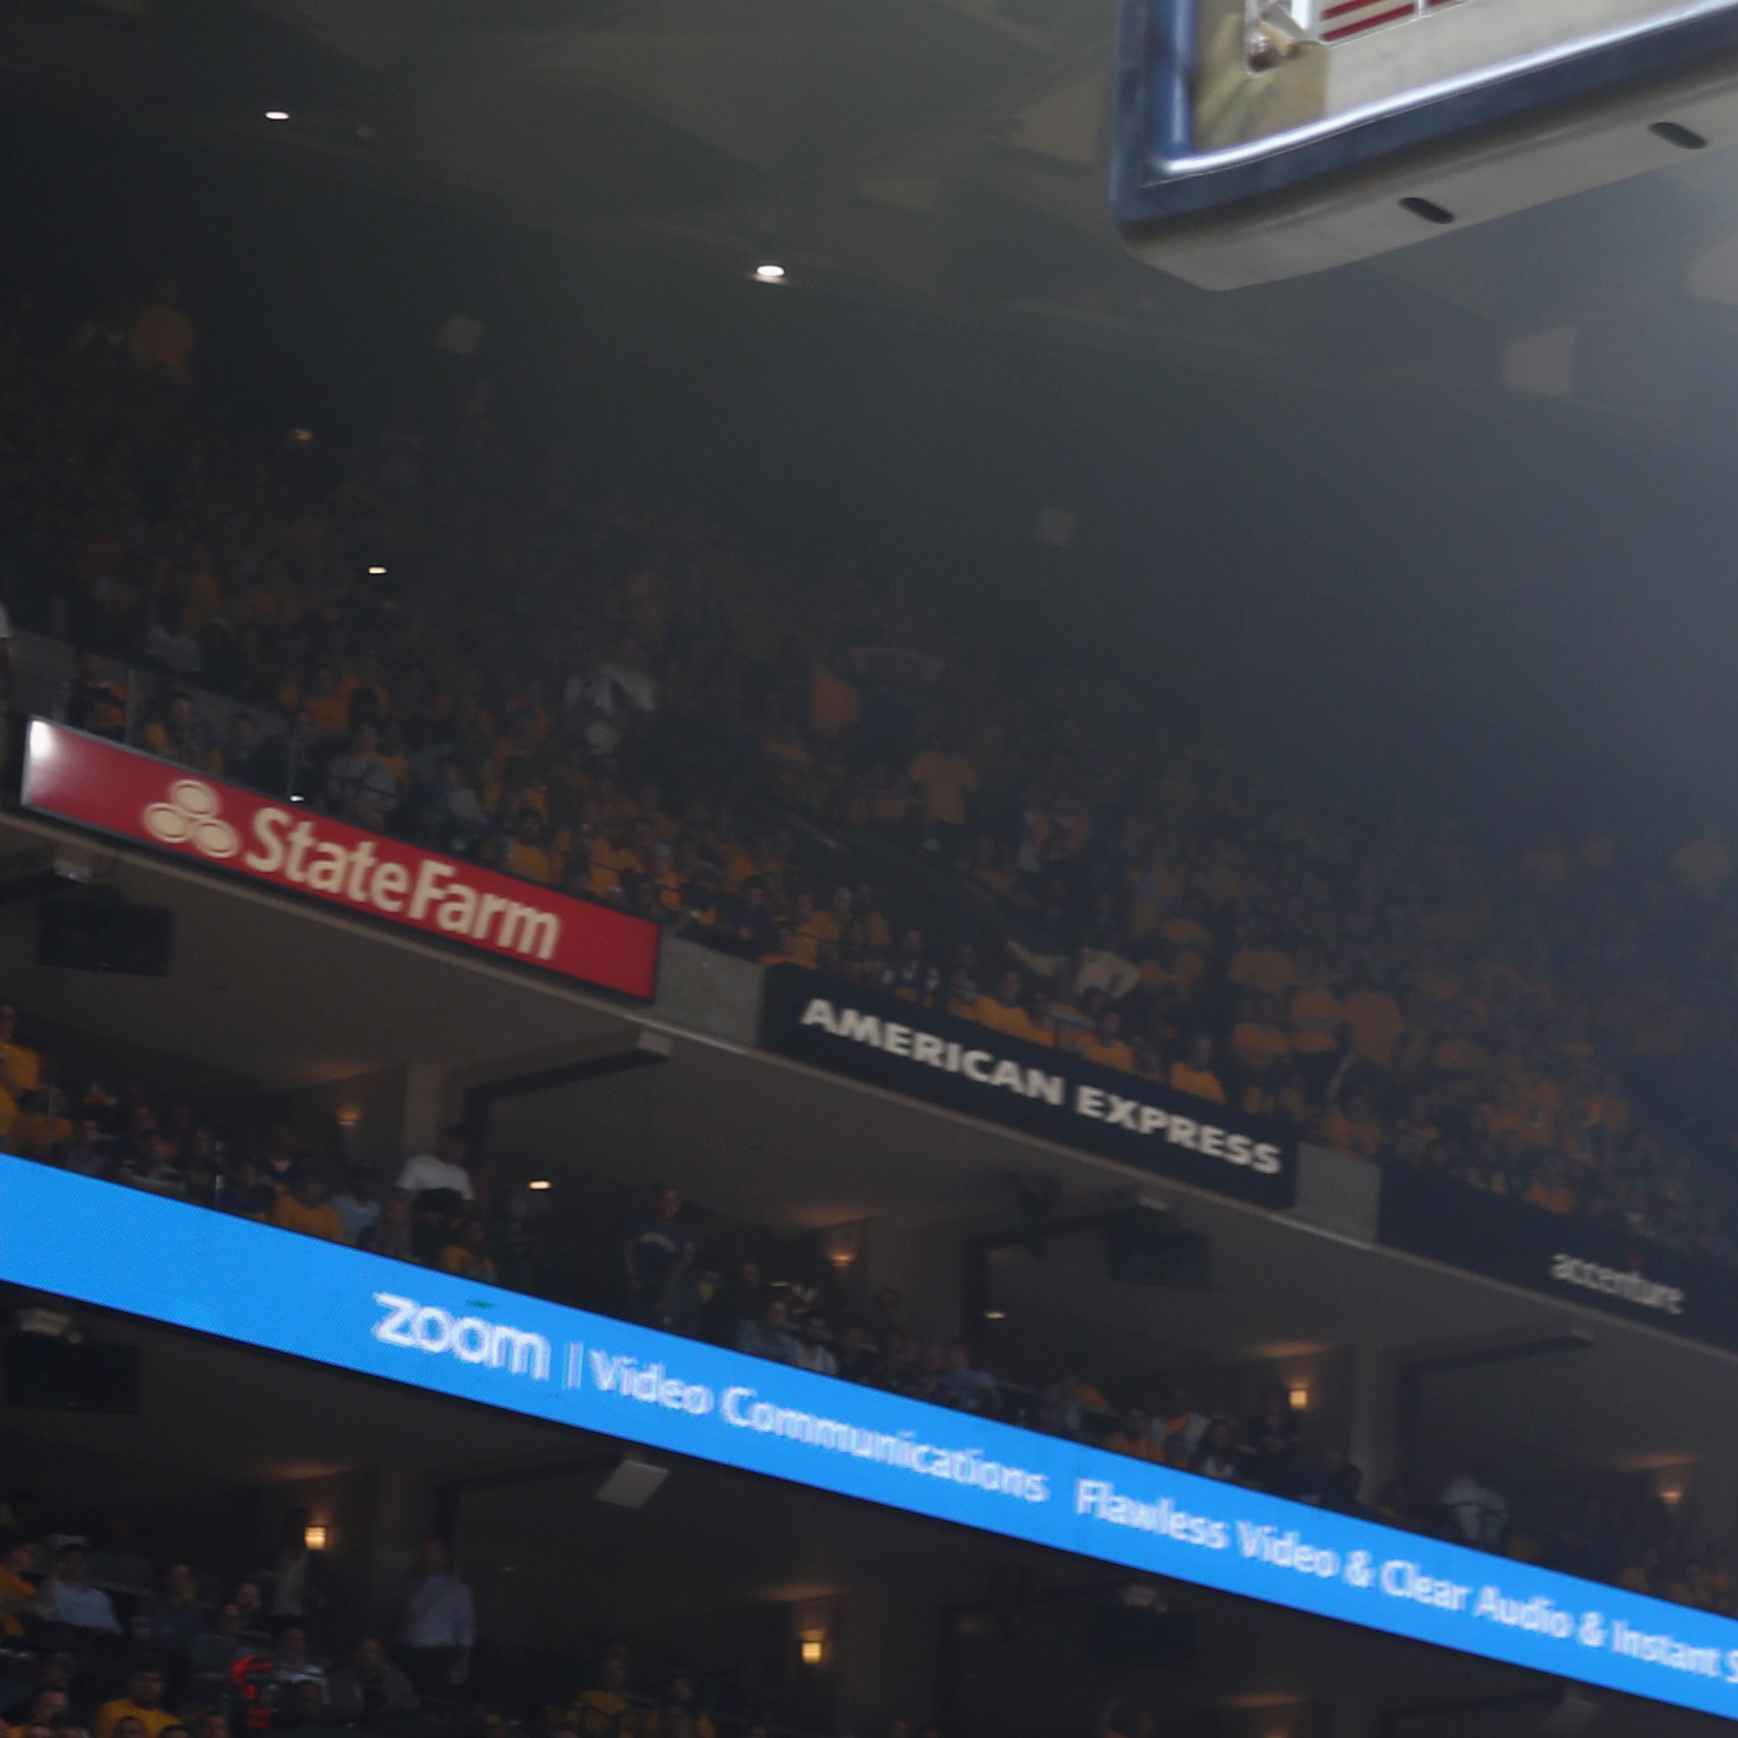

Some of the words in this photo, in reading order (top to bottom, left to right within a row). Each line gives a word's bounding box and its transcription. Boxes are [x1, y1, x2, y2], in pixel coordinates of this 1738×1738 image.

[802, 999, 1065, 1105] AMERICAN
[1075, 1084, 1281, 1174] EXPRESS
[373, 1290, 551, 1380] zoom
[589, 1347, 713, 1415] Video
[719, 1384, 1050, 1503] Communications
[1075, 1475, 1231, 1551] Flawless
[1237, 1519, 1336, 1579] Video
[1343, 1549, 1375, 1589] &
[1380, 1557, 1470, 1613] Clear
[1475, 1583, 1571, 1642] Audio
[1573, 1609, 1603, 1648] &
[1611, 1618, 1721, 1679] Instant
